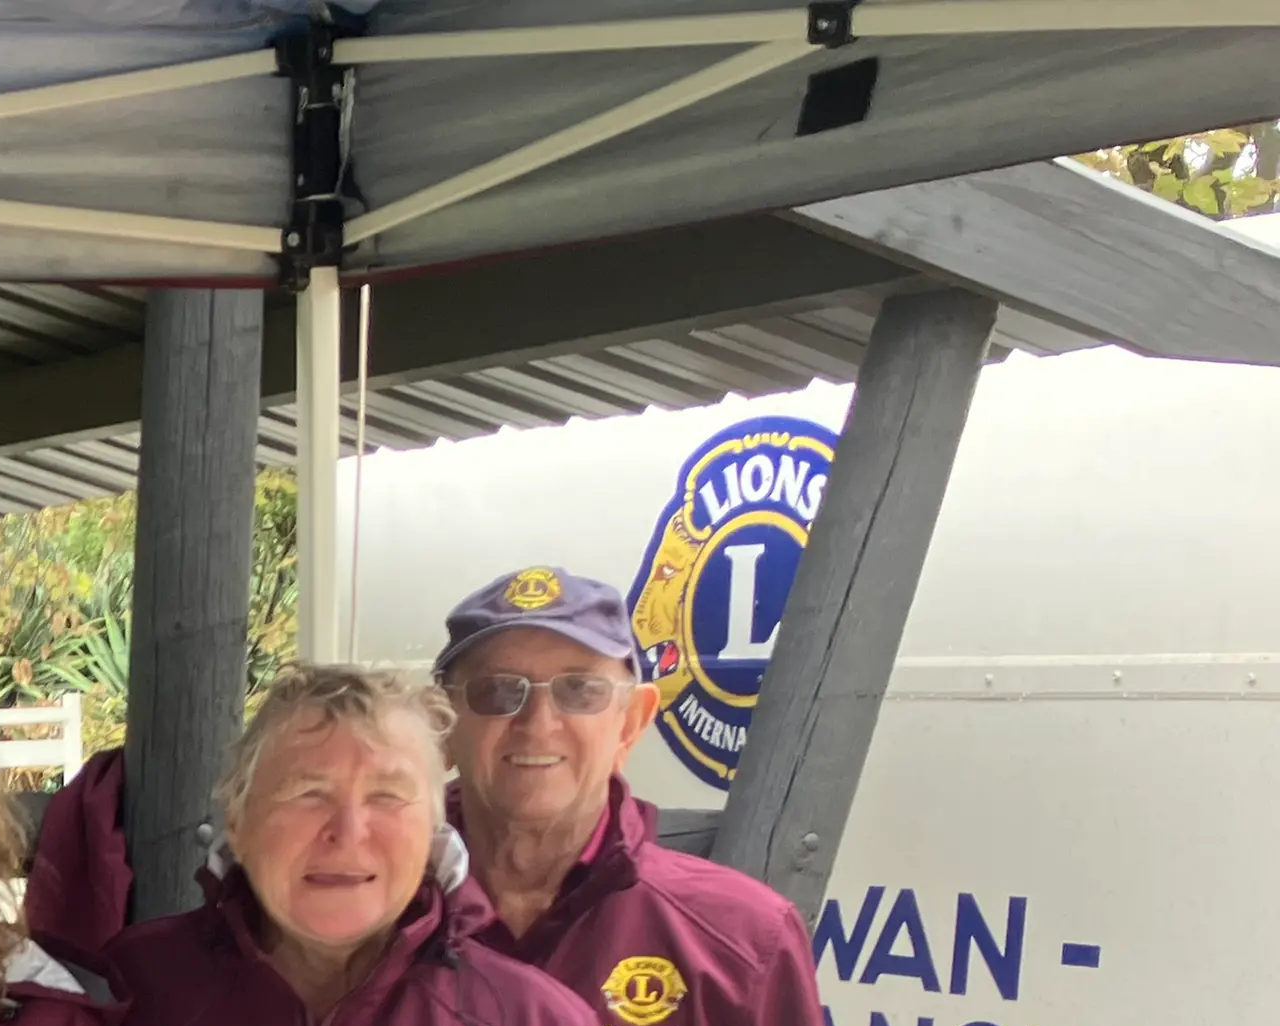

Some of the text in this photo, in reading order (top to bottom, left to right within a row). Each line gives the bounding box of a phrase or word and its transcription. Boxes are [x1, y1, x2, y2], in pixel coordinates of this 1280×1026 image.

[698, 454, 827, 524] LIONS
[716, 543, 781, 660] L
[631, 975, 659, 1003] L
